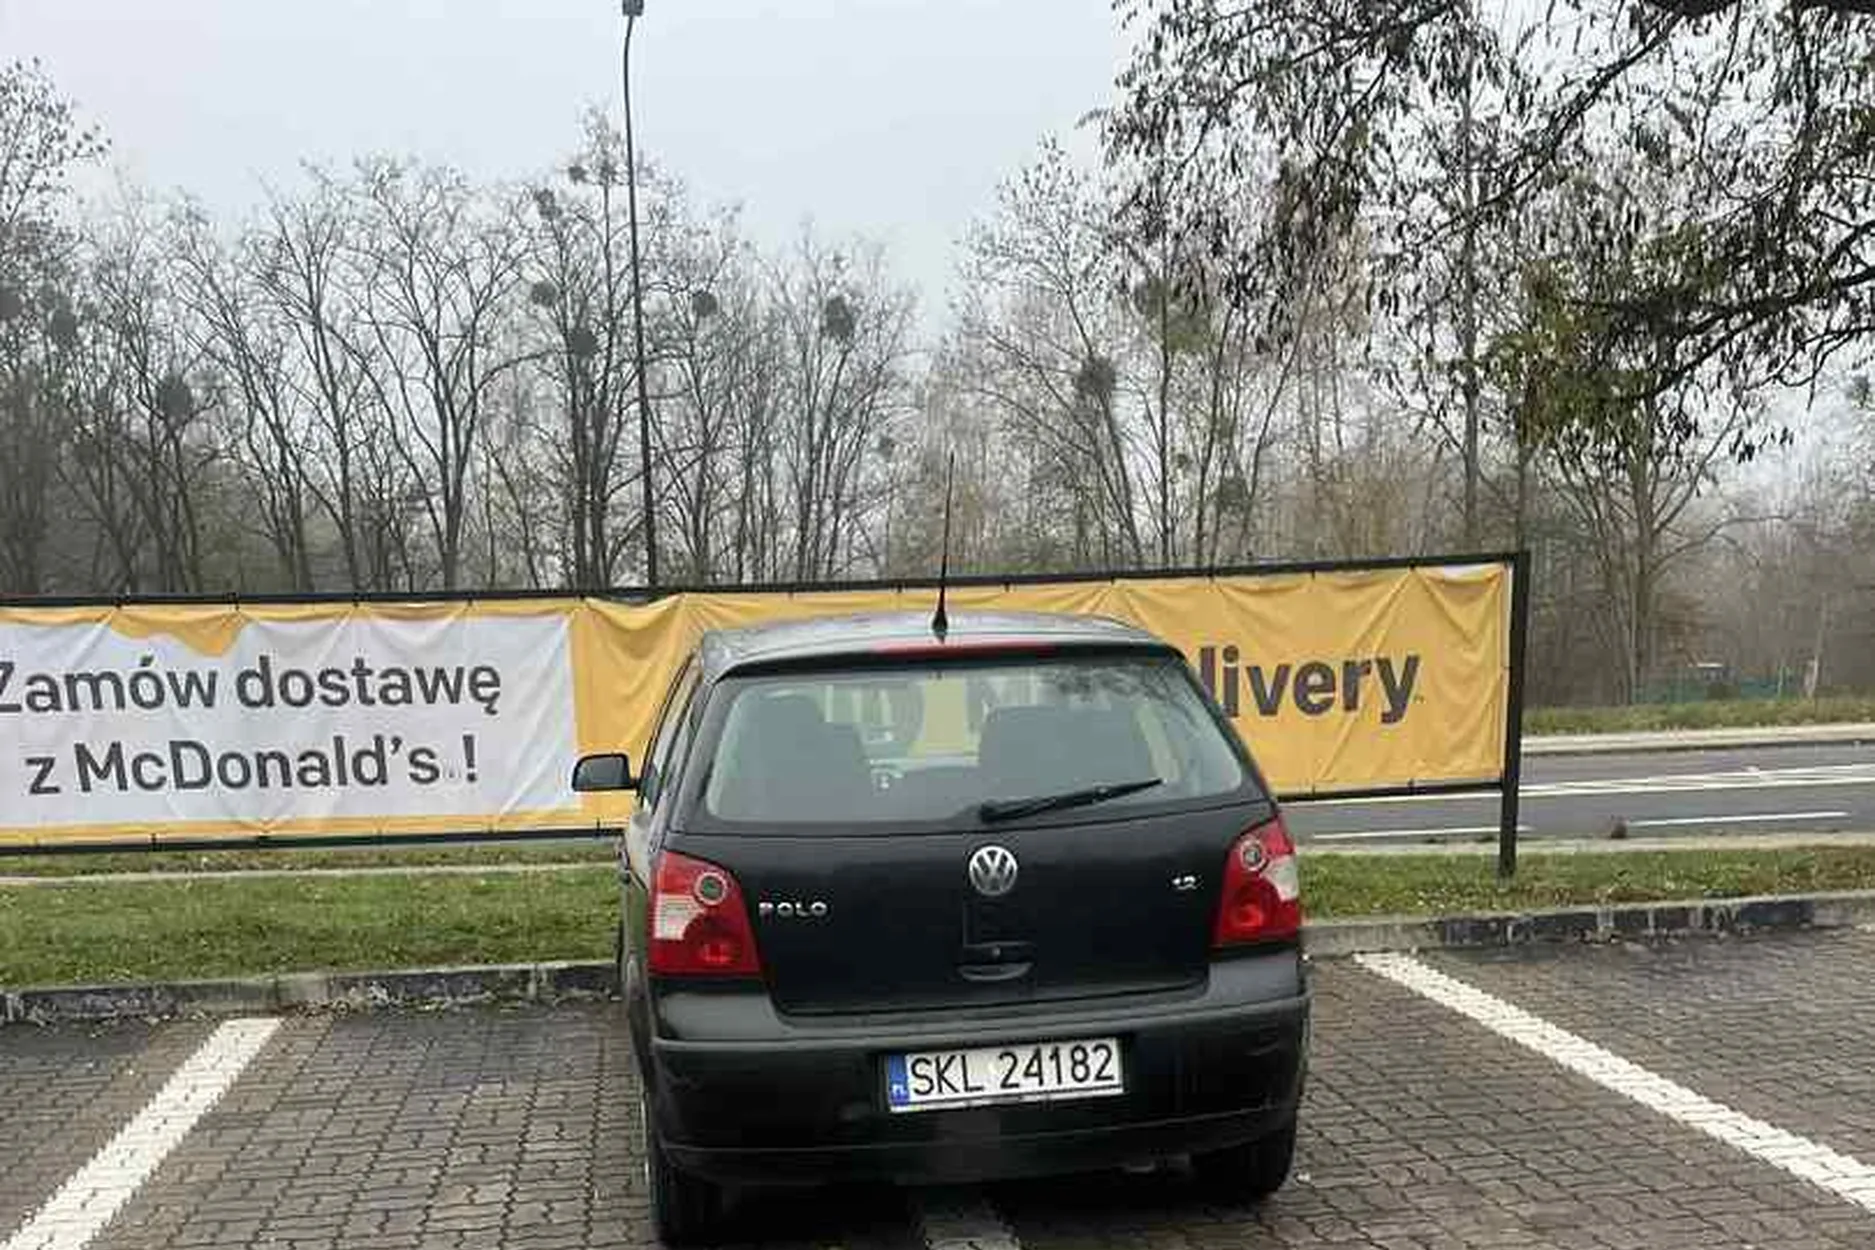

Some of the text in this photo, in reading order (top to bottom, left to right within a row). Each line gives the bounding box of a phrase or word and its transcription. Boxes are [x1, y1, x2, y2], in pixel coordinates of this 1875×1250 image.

[0, 655, 500, 714] Zamów dostawę
[25, 756, 61, 794] z
[759, 901, 828, 917] POLO
[910, 1043, 1115, 1096] SKL 24182
